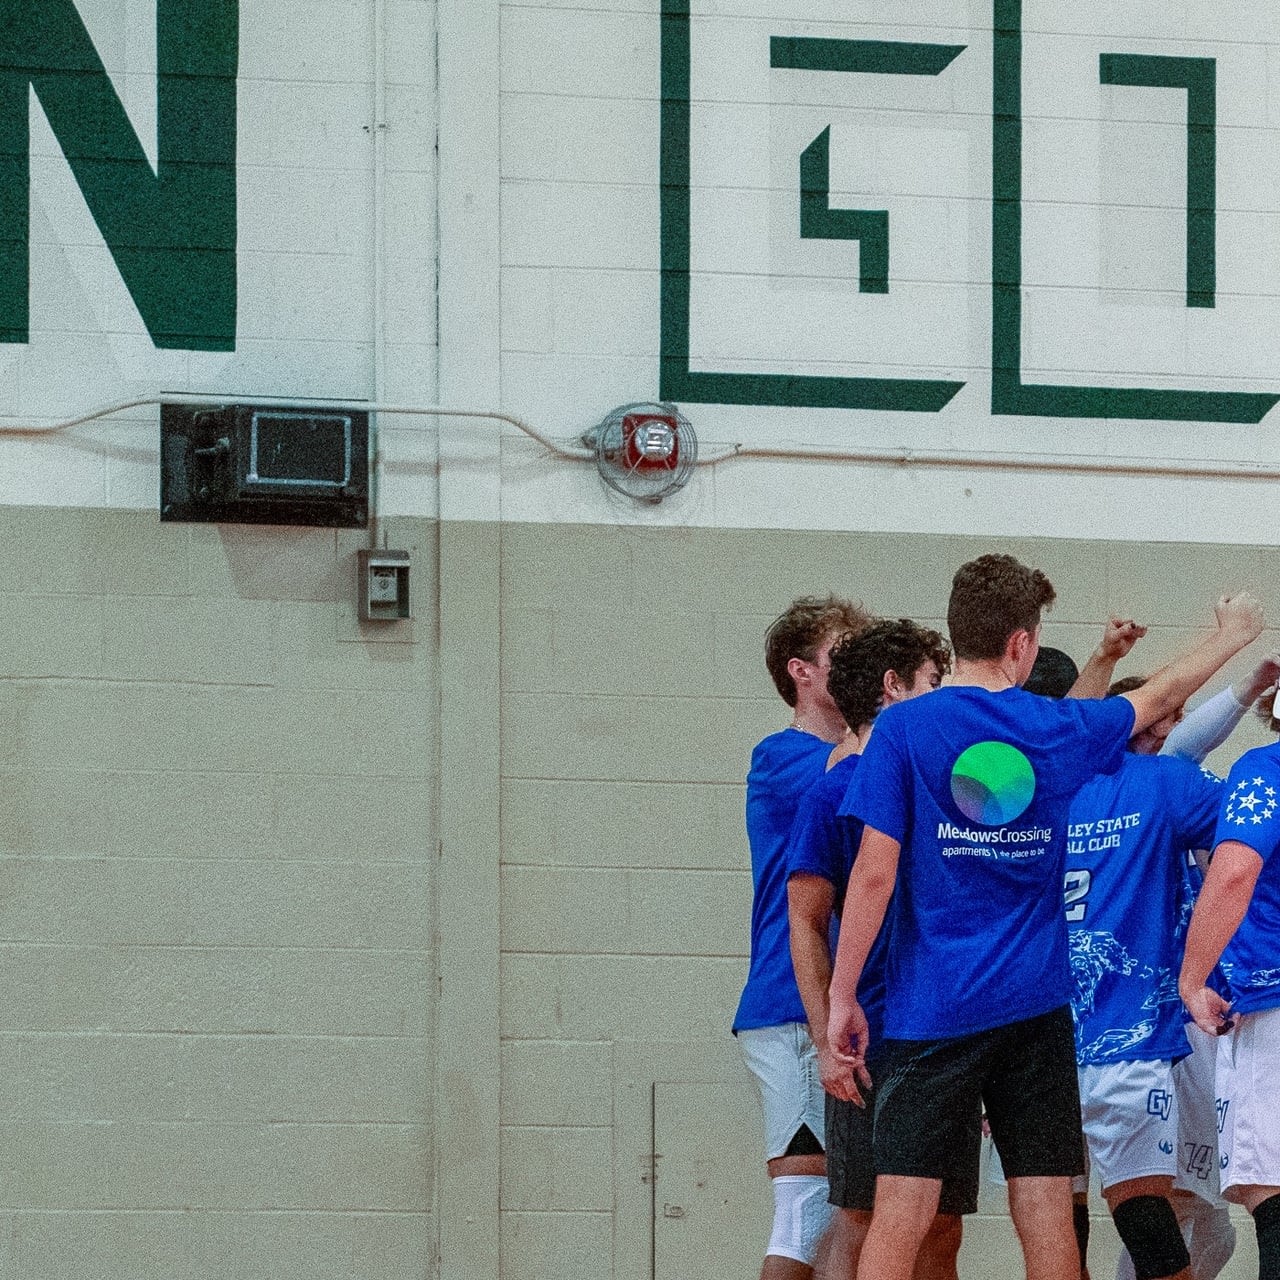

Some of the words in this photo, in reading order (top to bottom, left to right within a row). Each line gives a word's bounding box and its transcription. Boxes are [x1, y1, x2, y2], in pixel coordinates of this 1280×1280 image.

[1096, 813, 1140, 834] STATE
[1089, 834, 1121, 852] CLUB
[1011, 849, 1029, 859] place
[1147, 1089, 1172, 1121] GV
[1184, 1142, 1214, 1180] 74
